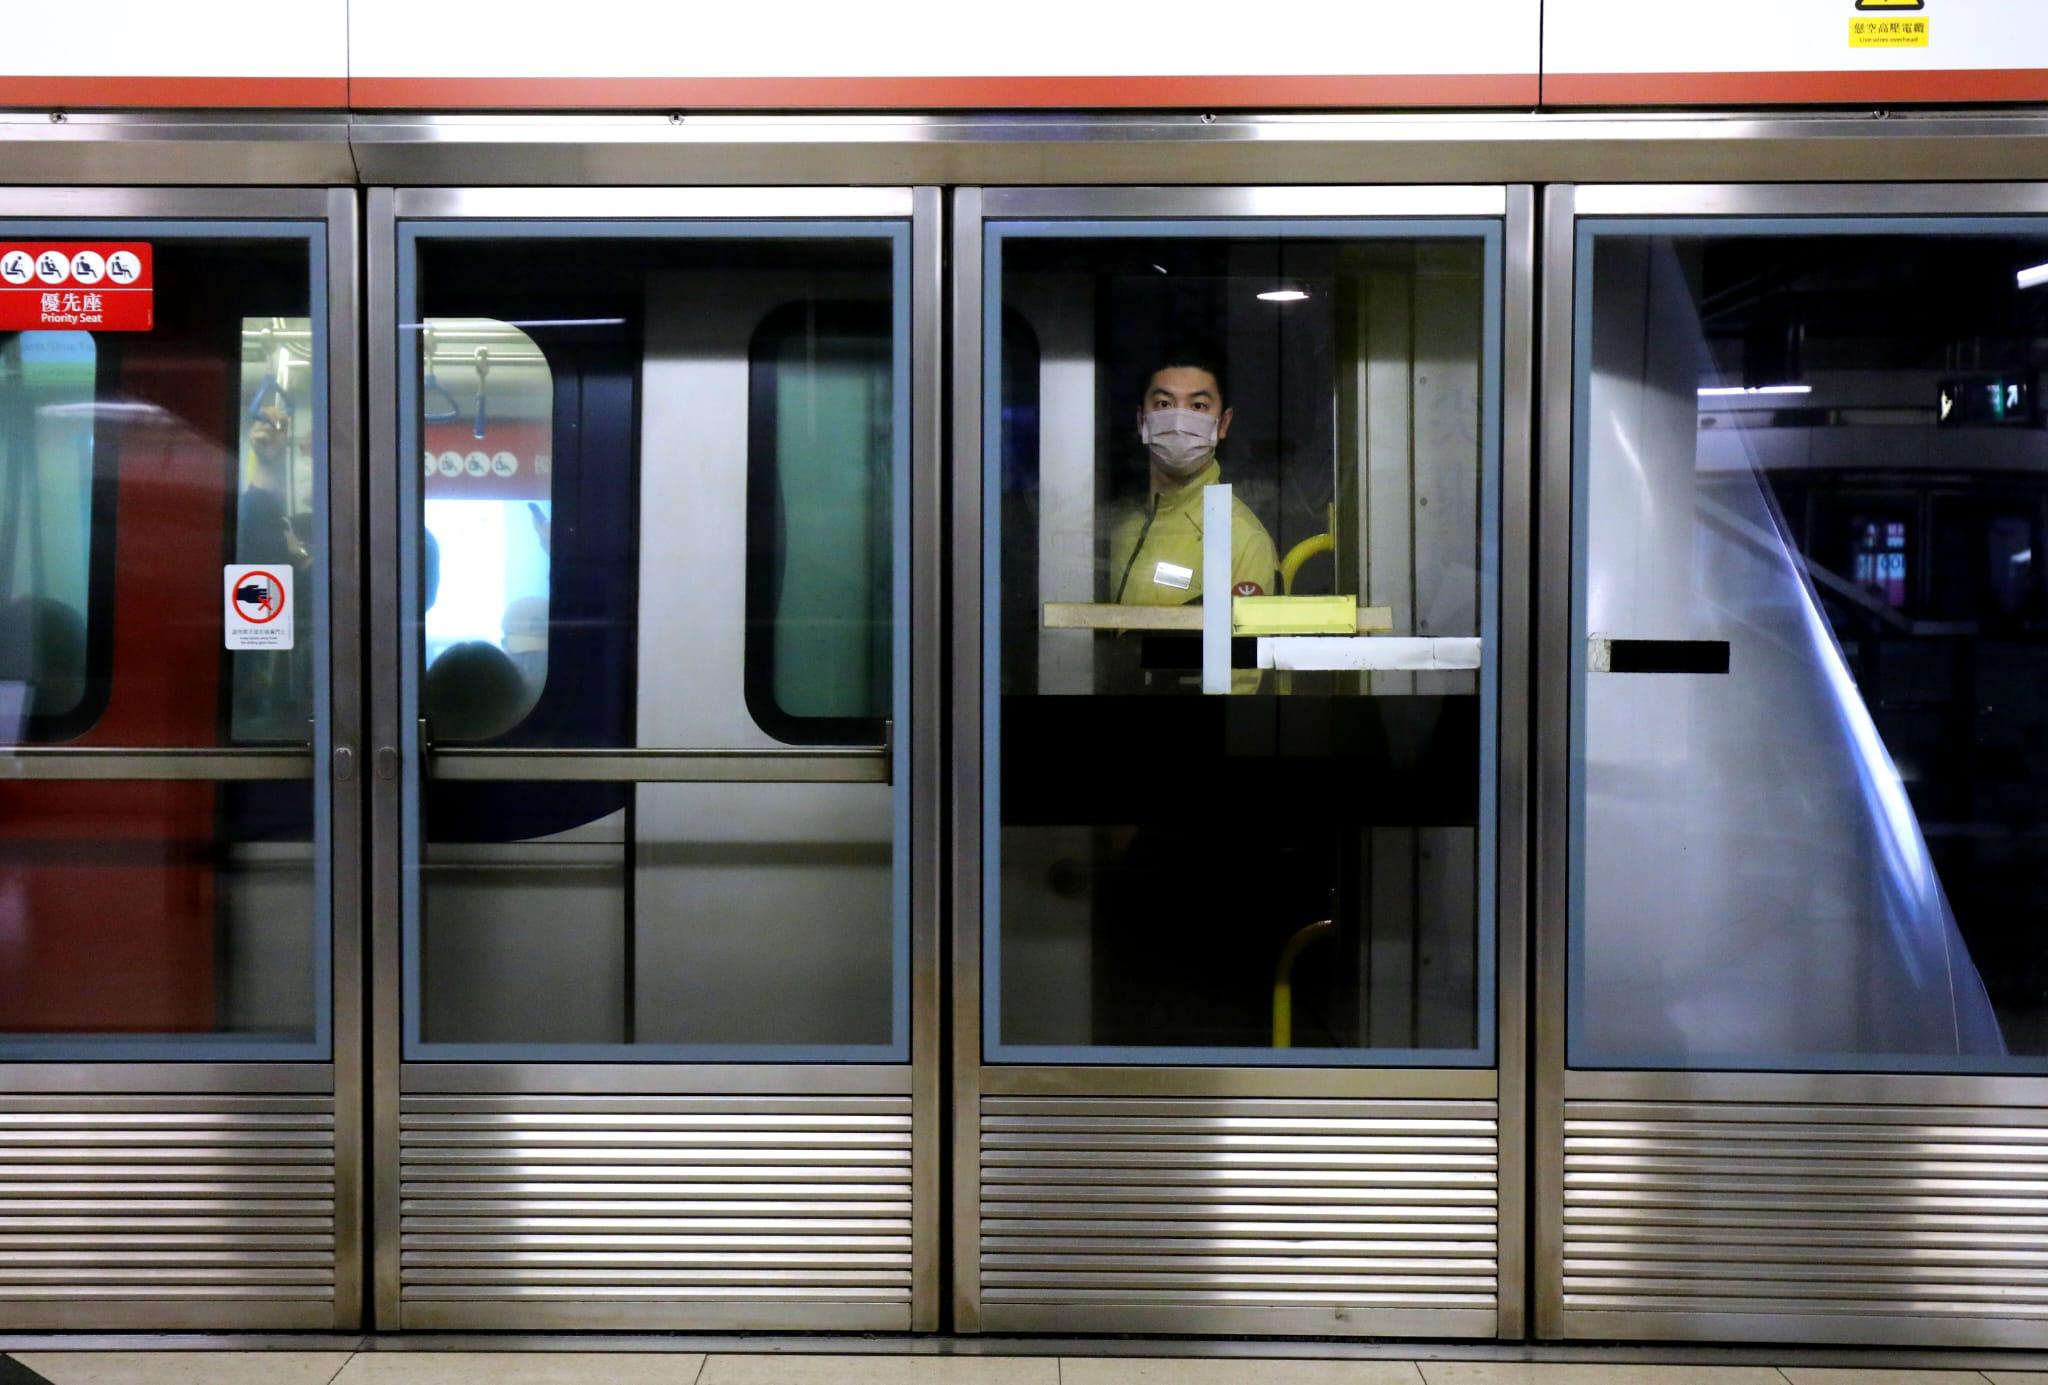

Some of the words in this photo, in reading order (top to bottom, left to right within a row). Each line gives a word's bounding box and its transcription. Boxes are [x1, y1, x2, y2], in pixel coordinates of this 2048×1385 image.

[41, 292, 103, 312] 優先座
[41, 313, 78, 324] Priority
[79, 313, 103, 323] Seat
